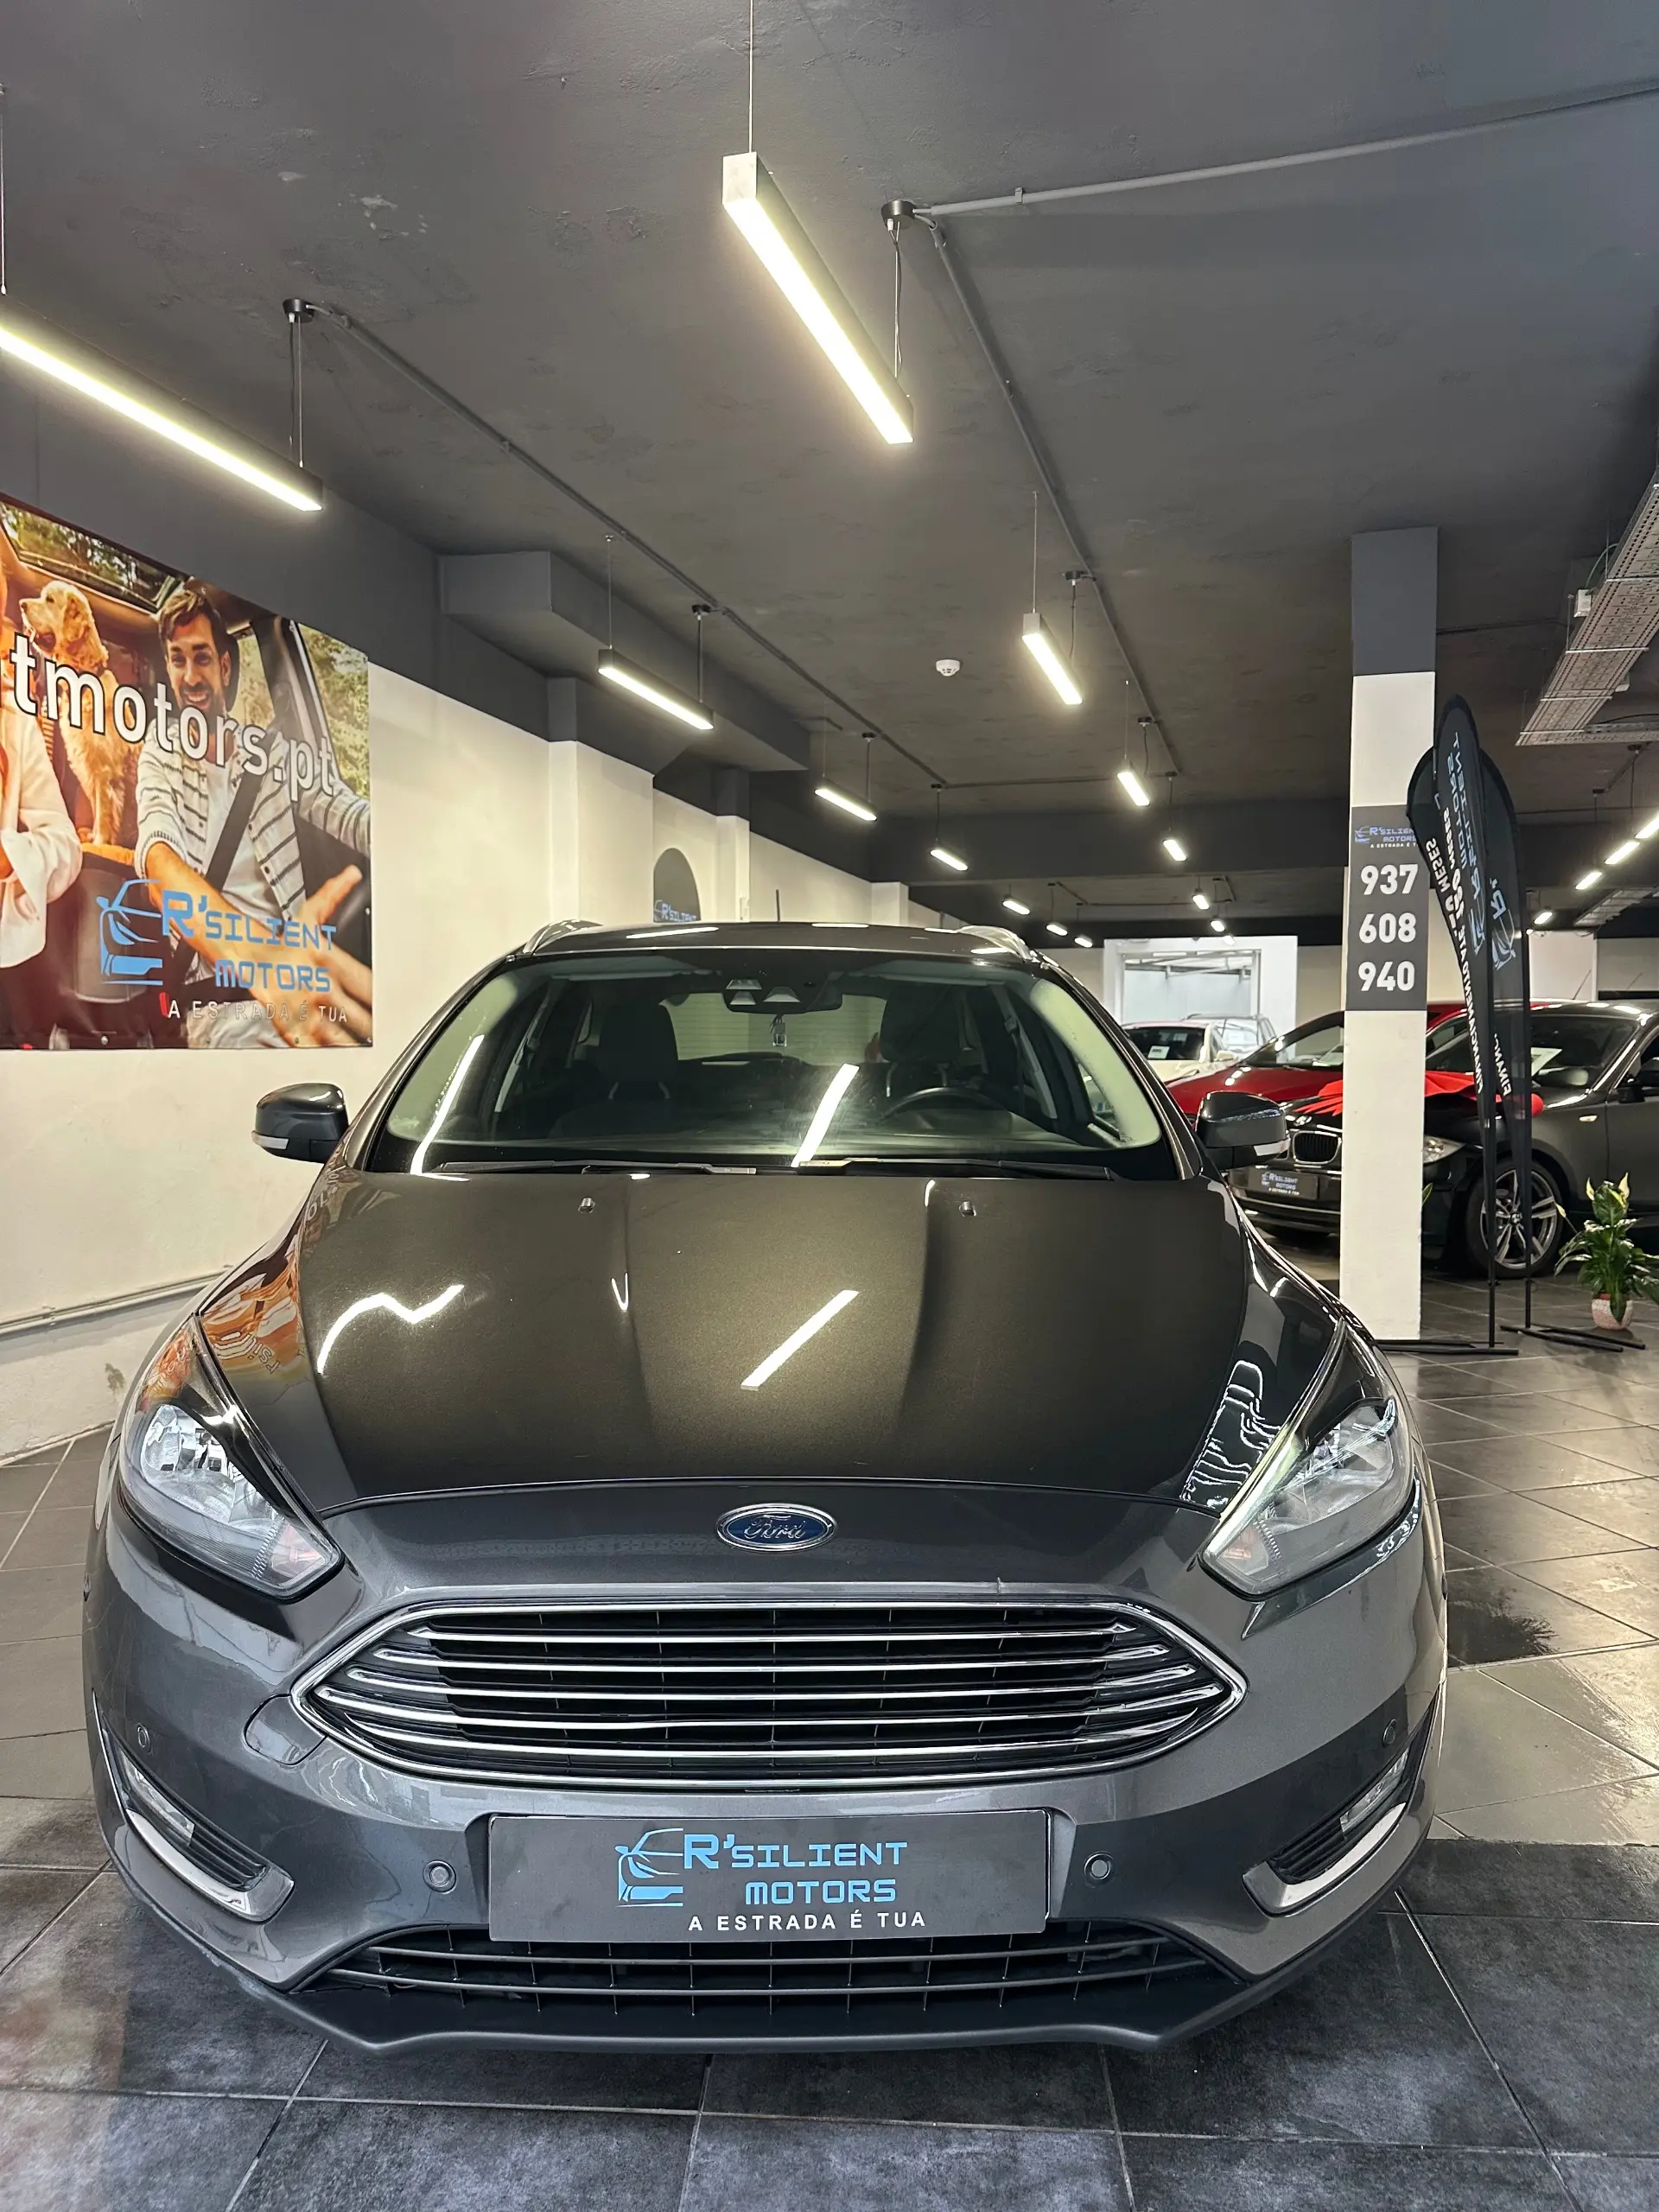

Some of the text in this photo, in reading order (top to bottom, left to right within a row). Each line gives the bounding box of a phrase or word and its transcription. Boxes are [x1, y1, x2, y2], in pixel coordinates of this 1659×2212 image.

[1370, 827, 1414, 836] R'SILIEN
[1360, 864, 1419, 895] 937
[162, 889, 336, 950] R'SILIENT
[1359, 912, 1416, 944] 608
[215, 959, 330, 992] MOTORS
[1357, 961, 1415, 992] 940
[168, 1000, 181, 1019] A
[193, 1001, 289, 1021] ESTRADA
[319, 1005, 347, 1023] TUA
[744, 1515, 806, 1539] Ford
[683, 1834, 907, 1869] R'SILIENT
[746, 1878, 896, 1904] MOTORS
[689, 1910, 925, 1930] A ESTRADA É TUA
